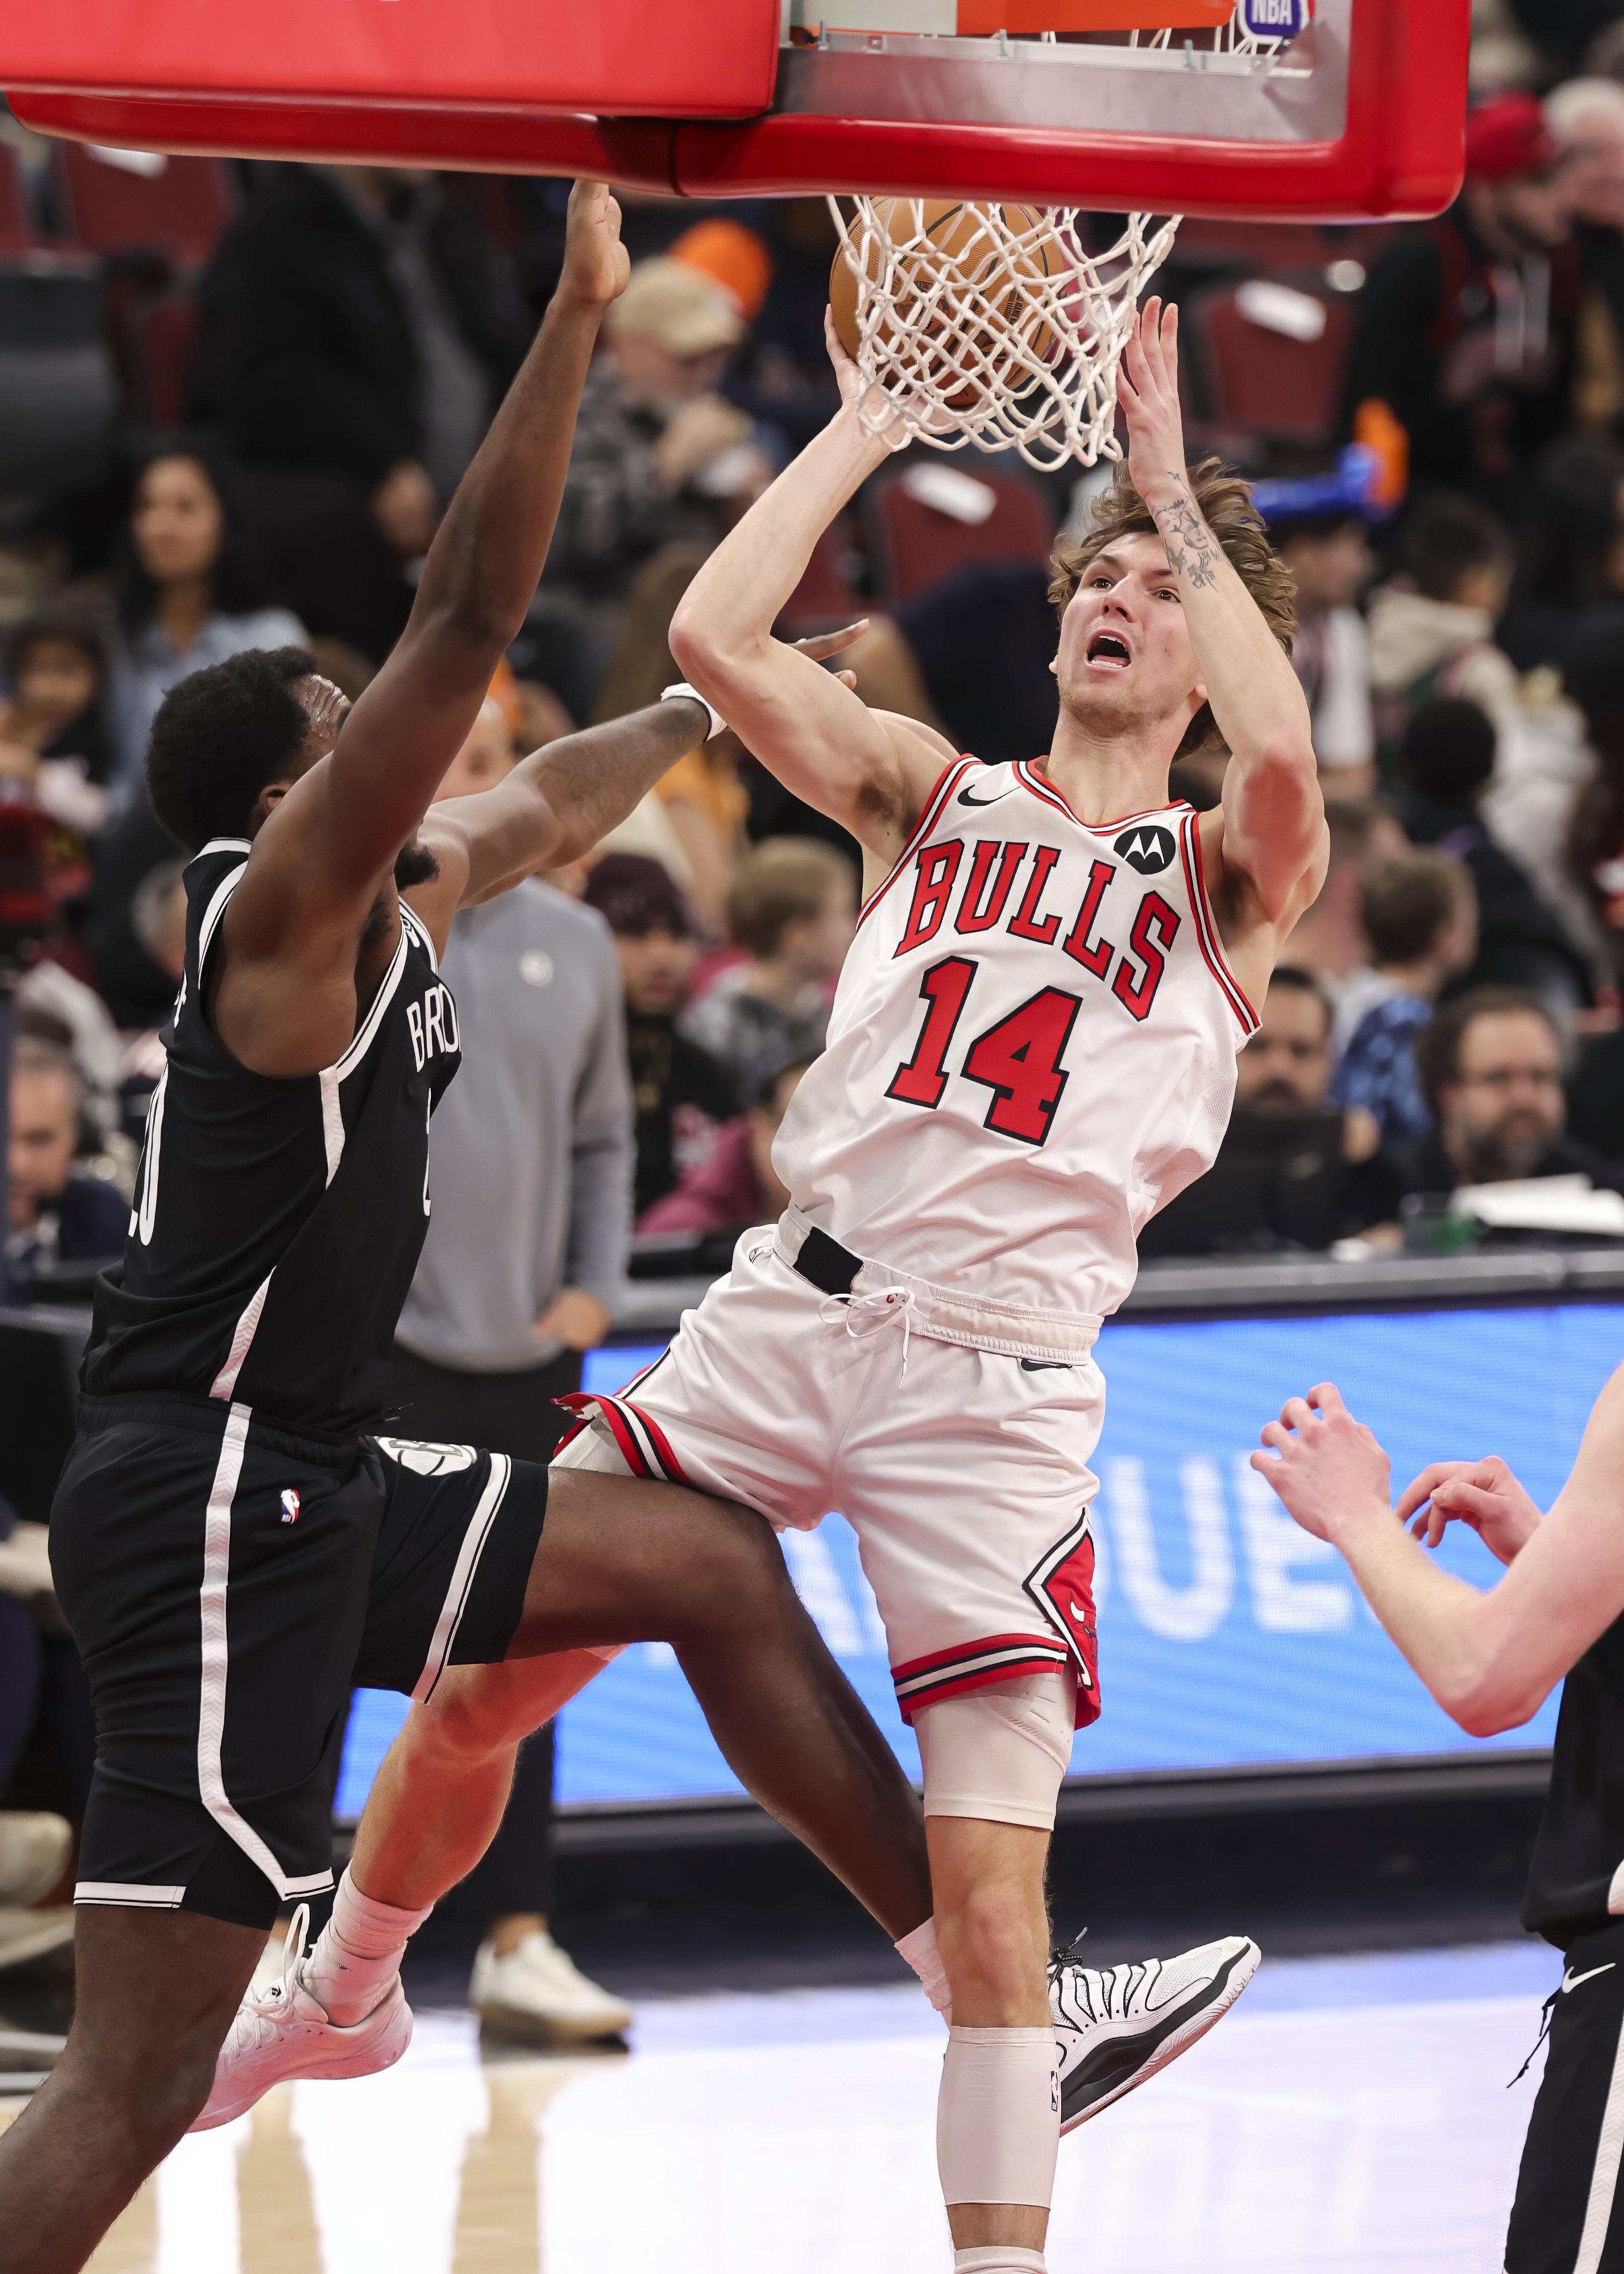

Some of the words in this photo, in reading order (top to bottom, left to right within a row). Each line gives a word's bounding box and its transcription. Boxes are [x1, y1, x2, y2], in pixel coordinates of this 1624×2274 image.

[1251, 0, 1293, 25] NBA
[892, 838, 1182, 1022] BULLS
[406, 982, 461, 1072] BRO
[883, 955, 1083, 1147] 14
